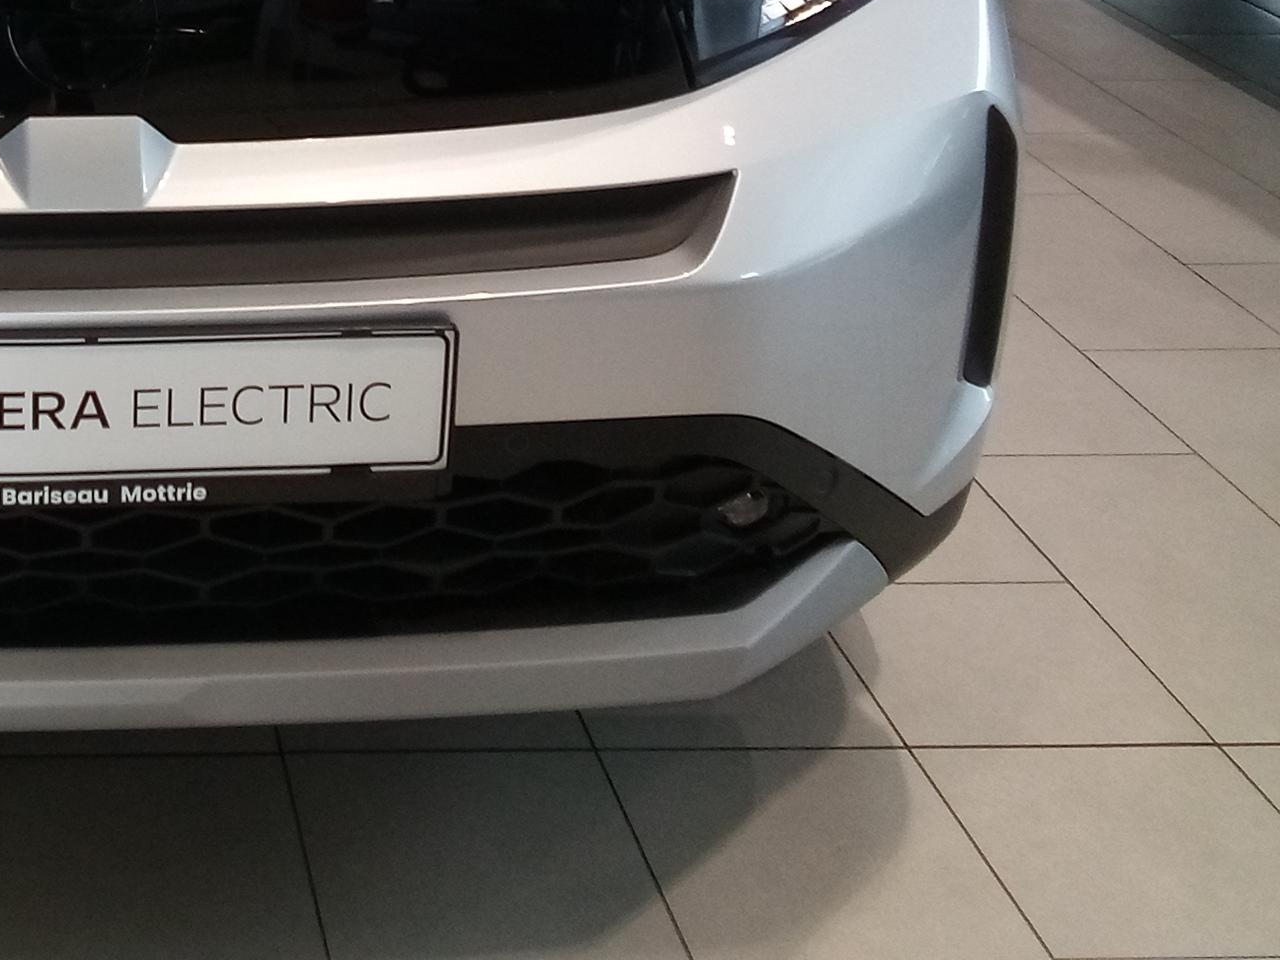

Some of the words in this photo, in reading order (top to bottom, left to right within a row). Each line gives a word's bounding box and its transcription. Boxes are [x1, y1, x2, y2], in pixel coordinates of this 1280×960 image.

[132, 381, 392, 429] ELECTRIC
[2, 485, 109, 506] Bariseau
[121, 482, 208, 503] Mottrie
